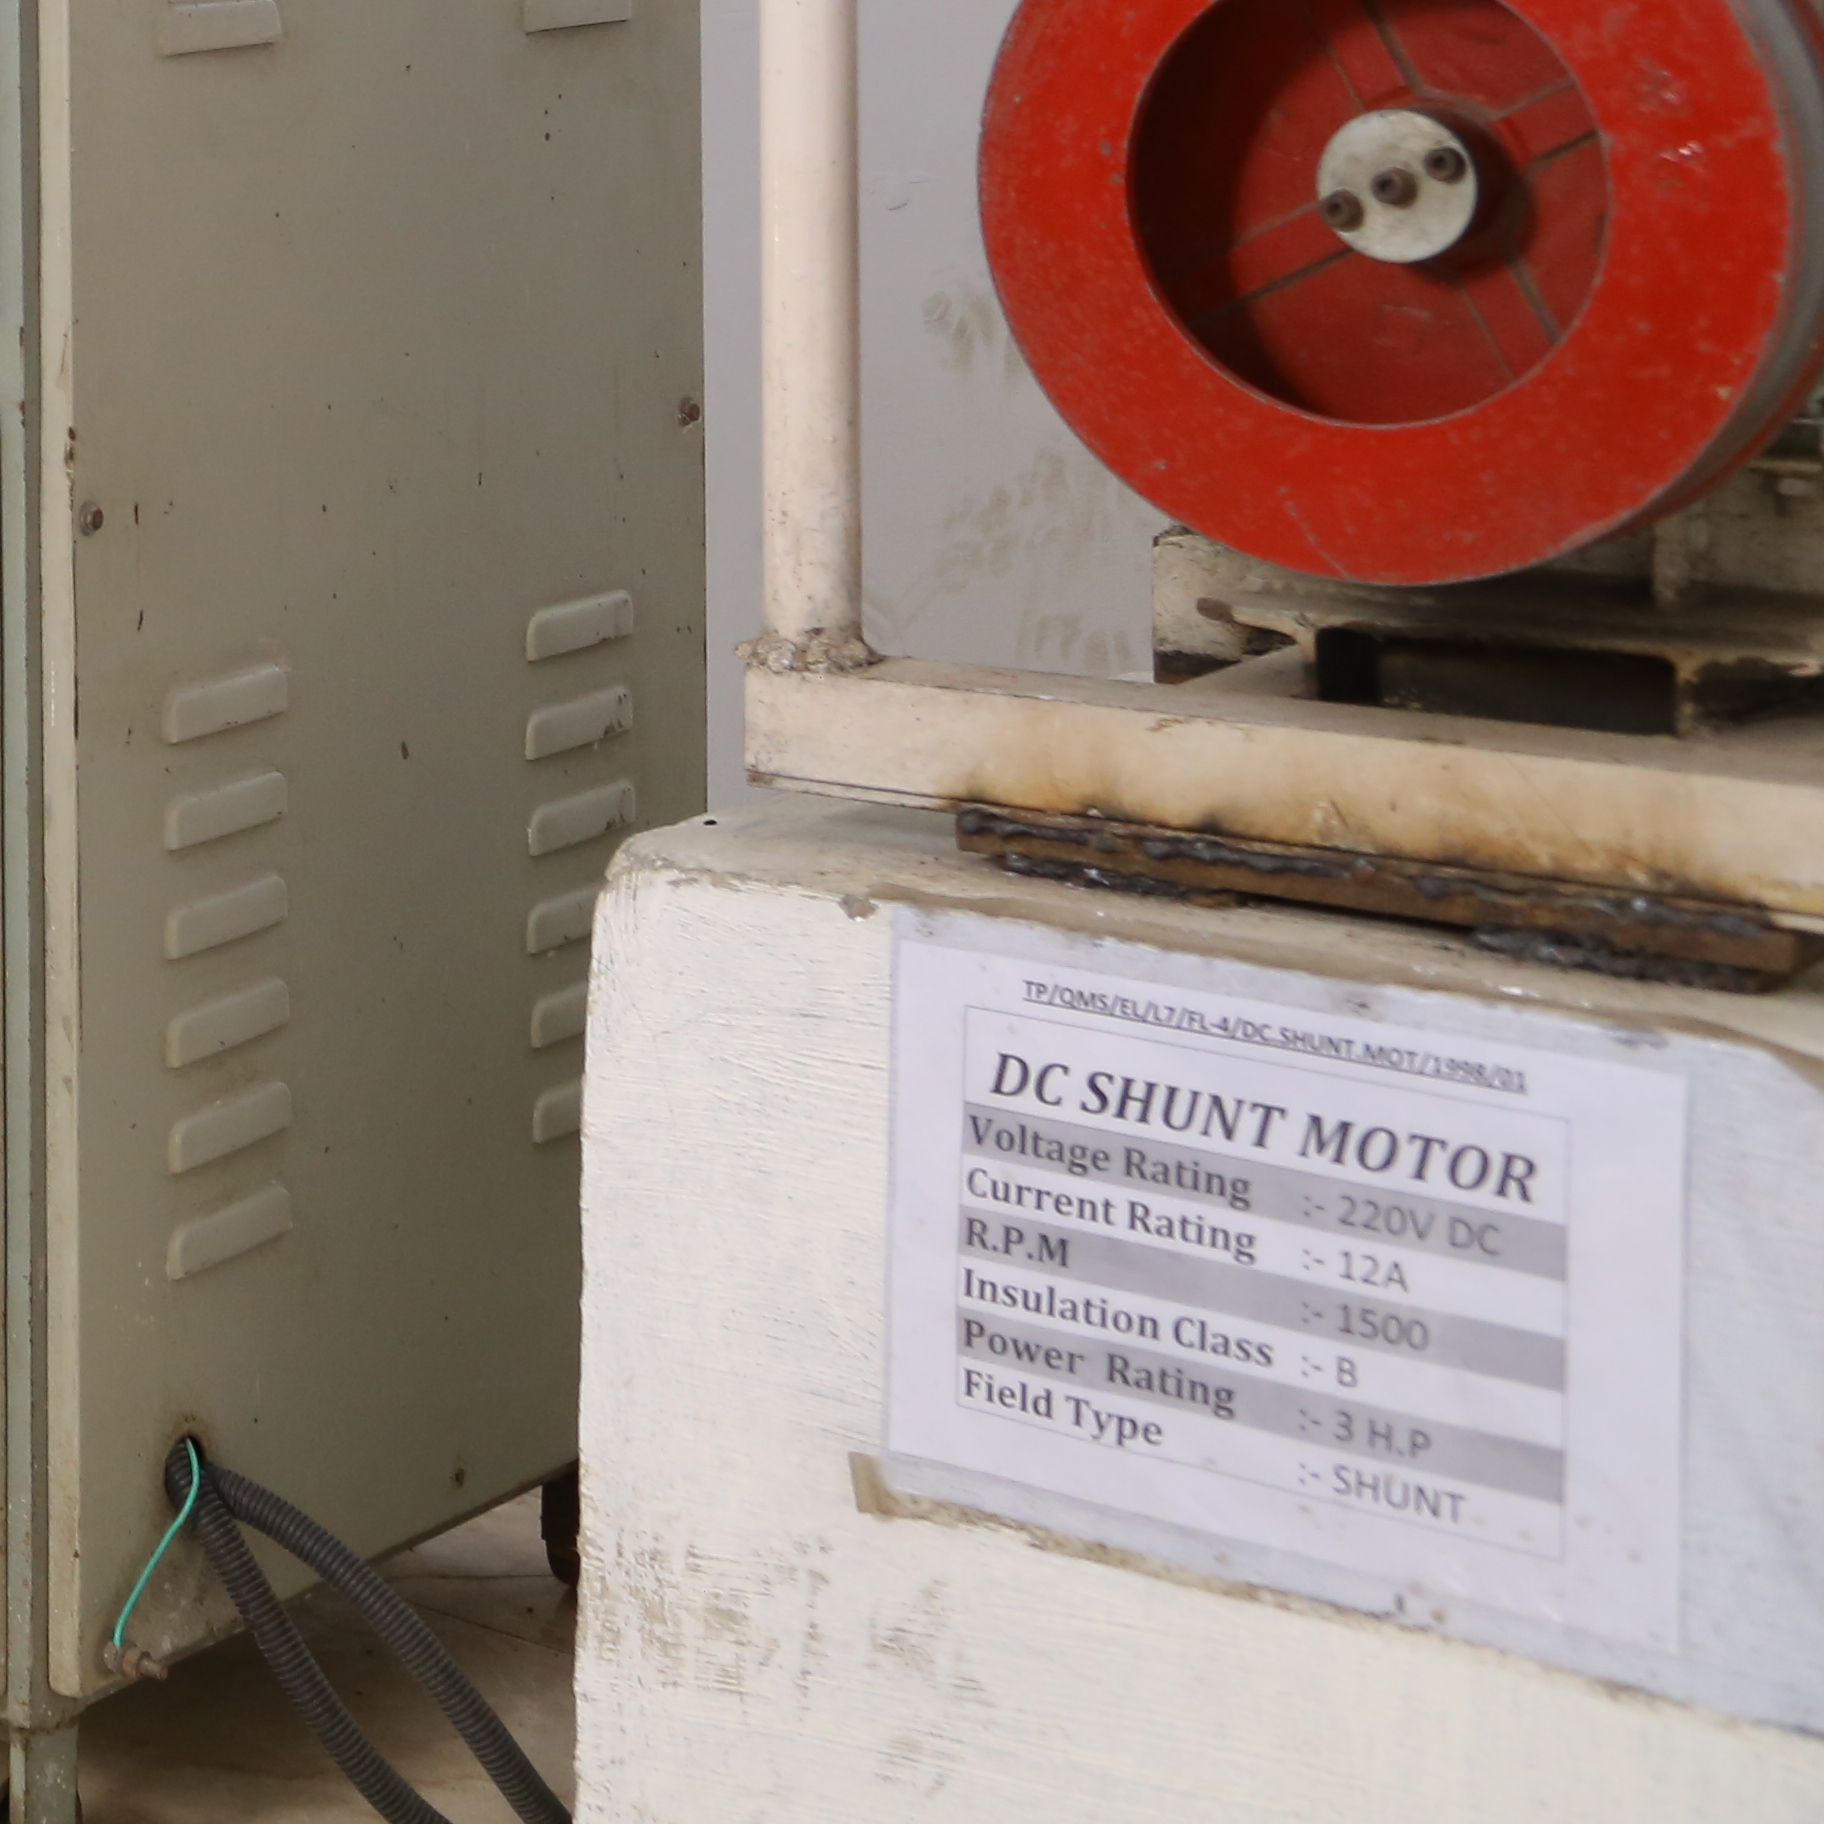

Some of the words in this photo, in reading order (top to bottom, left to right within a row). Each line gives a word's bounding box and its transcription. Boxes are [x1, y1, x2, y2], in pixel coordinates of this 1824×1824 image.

[969, 1115, 1109, 1176] Voltage
[1124, 1146, 1251, 1210] Rating
[1338, 1195, 1435, 1241] 220V
[1449, 1216, 1500, 1256] DC
[990, 1051, 1068, 1107] DC
[1080, 1070, 1285, 1150] SHUNT
[1301, 1113, 1538, 1204] MOTOR
[965, 1217, 1070, 1268] R.P.M
[1339, 1303, 1430, 1351] 1500
[967, 1168, 1116, 1227] Current
[1128, 1200, 1256, 1265] Rating
[1339, 1251, 1409, 1293] 12A
[963, 1267, 1160, 1341] Insulation
[1173, 1316, 1273, 1367] Class
[1337, 1356, 1357, 1388] B
[964, 1318, 1085, 1374] Power
[1107, 1353, 1235, 1419] Rating
[1334, 1411, 1352, 1442] 3
[1368, 1420, 1432, 1459] H.P
[964, 1368, 1053, 1419] Field
[1065, 1395, 1163, 1446] Type
[1333, 1464, 1465, 1523] SHUNT
